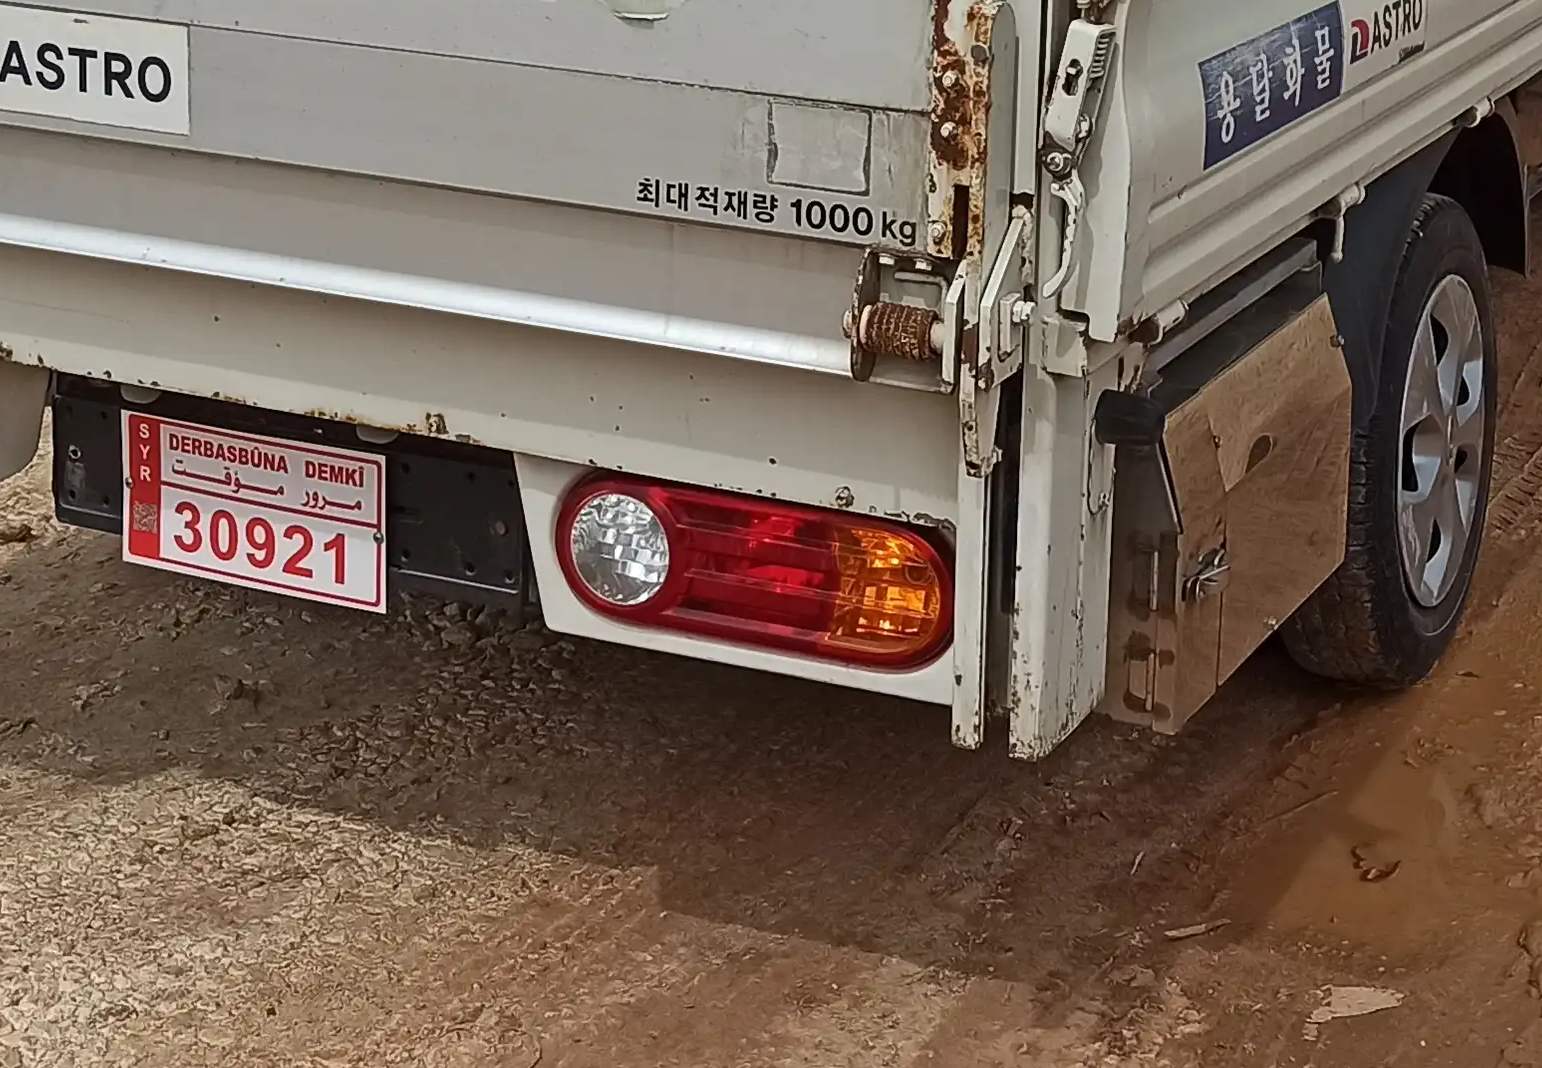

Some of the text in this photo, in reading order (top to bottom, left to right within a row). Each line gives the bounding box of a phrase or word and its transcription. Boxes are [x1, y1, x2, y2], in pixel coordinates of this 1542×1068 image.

[1216, 26, 1335, 144] 용달화물
[636, 177, 779, 224] 최대적재량
[168, 433, 365, 488] DERBASBÛNA DEMKÎ
[301, 488, 362, 511] مرور
[174, 501, 346, 585] 30921
